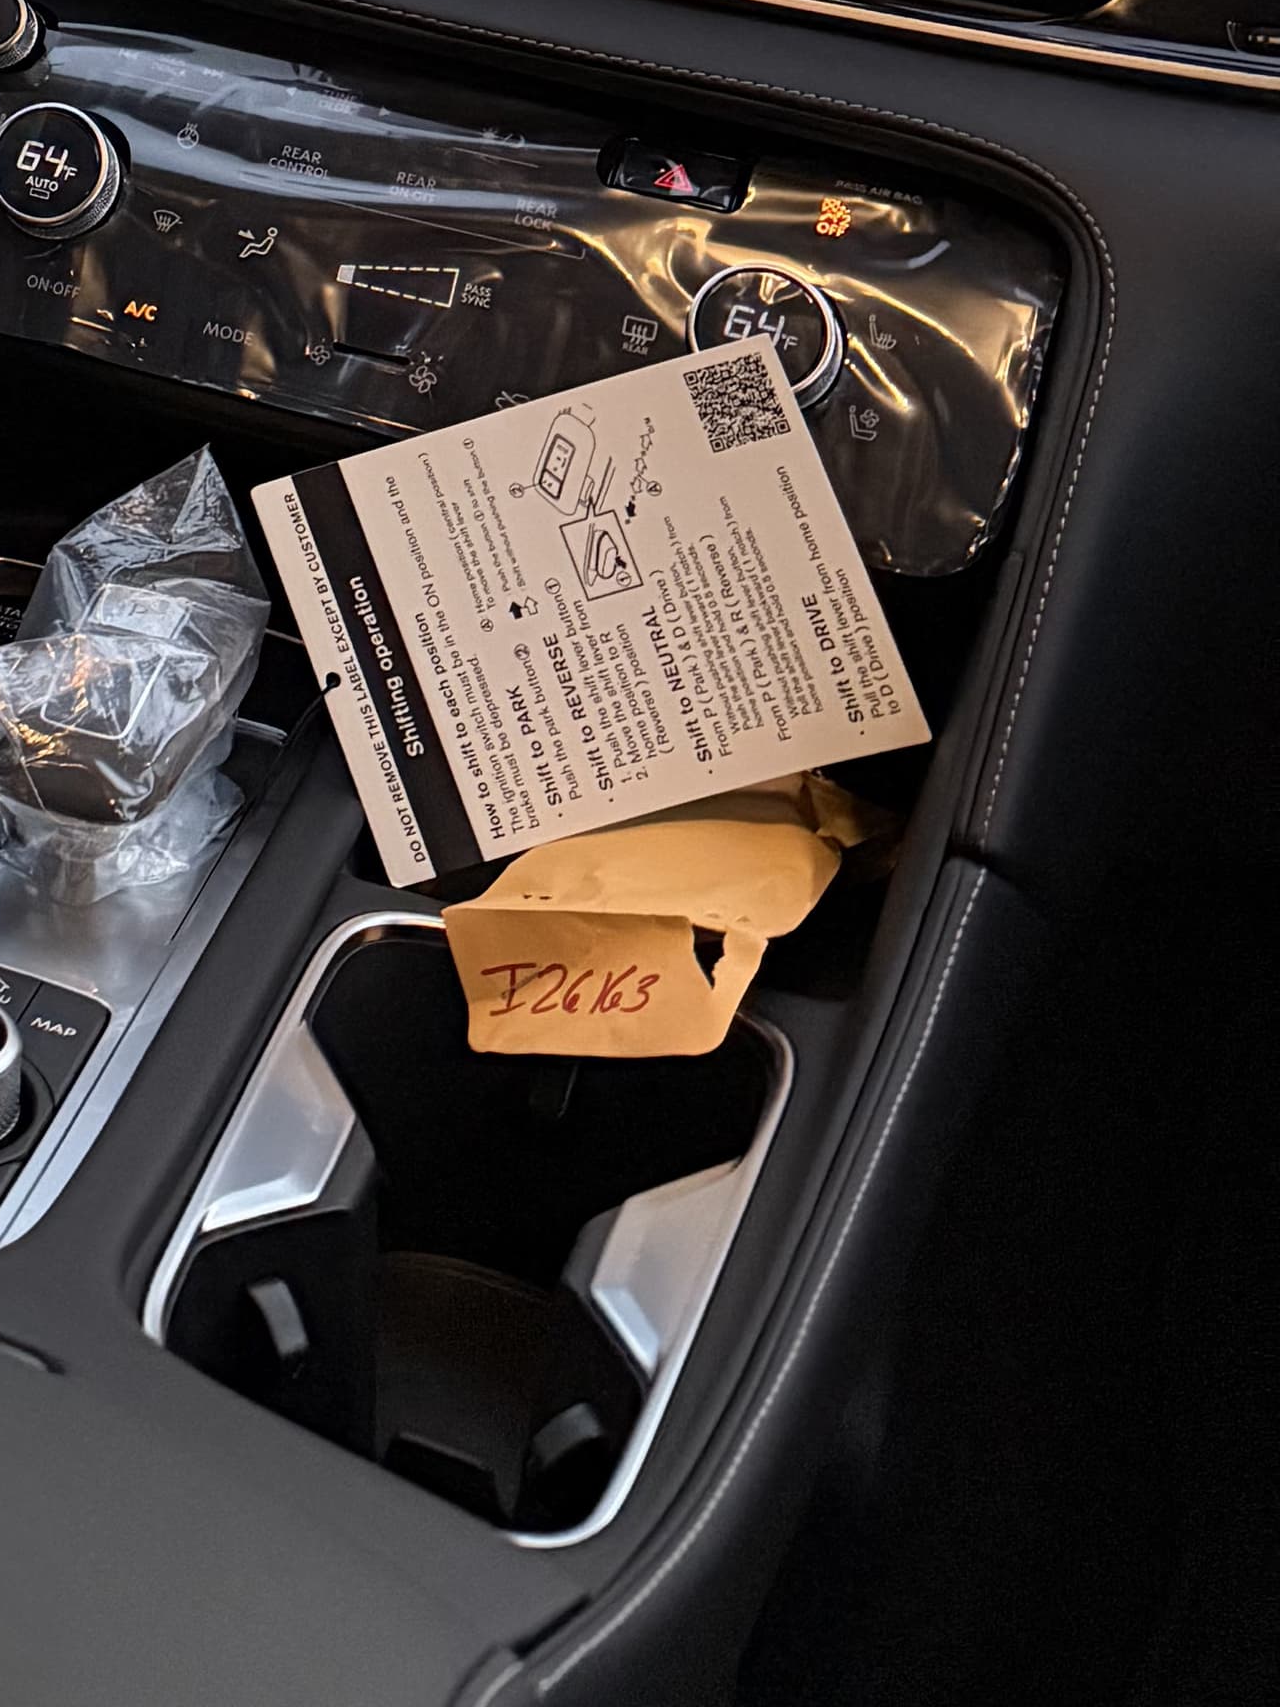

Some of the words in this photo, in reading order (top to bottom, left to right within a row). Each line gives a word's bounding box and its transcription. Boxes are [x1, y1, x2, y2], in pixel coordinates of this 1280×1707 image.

[16, 140, 69, 178] 64
[268, 156, 329, 180] CONTROL
[281, 145, 322, 165] REAR
[25, 175, 59, 193] AUTO
[396, 171, 437, 190] REAR
[870, 185, 891, 199] AIR
[514, 213, 554, 233] LOCK
[515, 197, 558, 220] REAR
[816, 221, 850, 237] OFF
[460, 292, 492, 310] SYNC
[463, 283, 492, 299] PASS
[123, 300, 158, 322] A/C
[723, 304, 785, 348] 64
[202, 321, 257, 347] MODE
[622, 342, 649, 356] REAR
[384, 475, 401, 498] the
[775, 464, 808, 520] position
[390, 498, 411, 525] and
[282, 492, 320, 573] CUSTOMER
[797, 520, 822, 562] home
[404, 526, 435, 580] position
[311, 575, 329, 595] BY
[814, 561, 836, 595] from
[420, 581, 441, 608] ON
[319, 598, 350, 654] EXCEPT
[348, 575, 393, 671] operation
[434, 609, 450, 633] the
[571, 598, 592, 631] from
[800, 592, 837, 652] DRIVE
[827, 596, 851, 632] lever
[413, 611, 448, 676] position
[442, 633, 457, 649] in
[569, 639, 591, 674] lever
[583, 632, 605, 667] lever
[640, 604, 686, 693] NEUTRAL
[840, 630, 864, 664] shift
[449, 649, 464, 670] be
[829, 655, 845, 676] to
[342, 654, 368, 702] LABEL
[454, 669, 478, 705] must
[464, 655, 504, 730] depressed.
[541, 632, 587, 721] REVERSE
[582, 673, 603, 705] shift
[595, 666, 618, 698] shift
[855, 664, 874, 689] the
[436, 678, 461, 718] each
[504, 684, 537, 736] PARK
[609, 699, 628, 724] the
[678, 695, 694, 715] to
[834, 677, 865, 723] Shift
[861, 689, 886, 719] Pull
[358, 702, 381, 740] THIS
[385, 674, 425, 757] Shifting
[454, 720, 469, 739] to
[468, 705, 496, 752] switch
[536, 704, 562, 738] park
[596, 705, 613, 730] the
[496, 730, 512, 752] be
[529, 739, 545, 759] to
[580, 723, 596, 744] to
[603, 730, 628, 769] Push
[620, 724, 643, 764] Move
[684, 716, 713, 763] Shift
[458, 740, 484, 778] shift
[551, 738, 568, 763] the
[371, 739, 404, 803] REMOVE
[487, 752, 516, 804] ignition
[501, 751, 525, 788] must
[534, 761, 563, 807] Shift
[558, 762, 583, 801] Push
[585, 745, 614, 791] Shift
[619, 770, 633, 784] 1.
[634, 764, 649, 781] 2.
[476, 780, 491, 800] to
[395, 806, 417, 837] NOT
[483, 802, 506, 840] How
[507, 805, 525, 835] The
[518, 788, 541, 830] brake
[408, 838, 426, 863] DO
[30, 1017, 78, 1037] MAP
